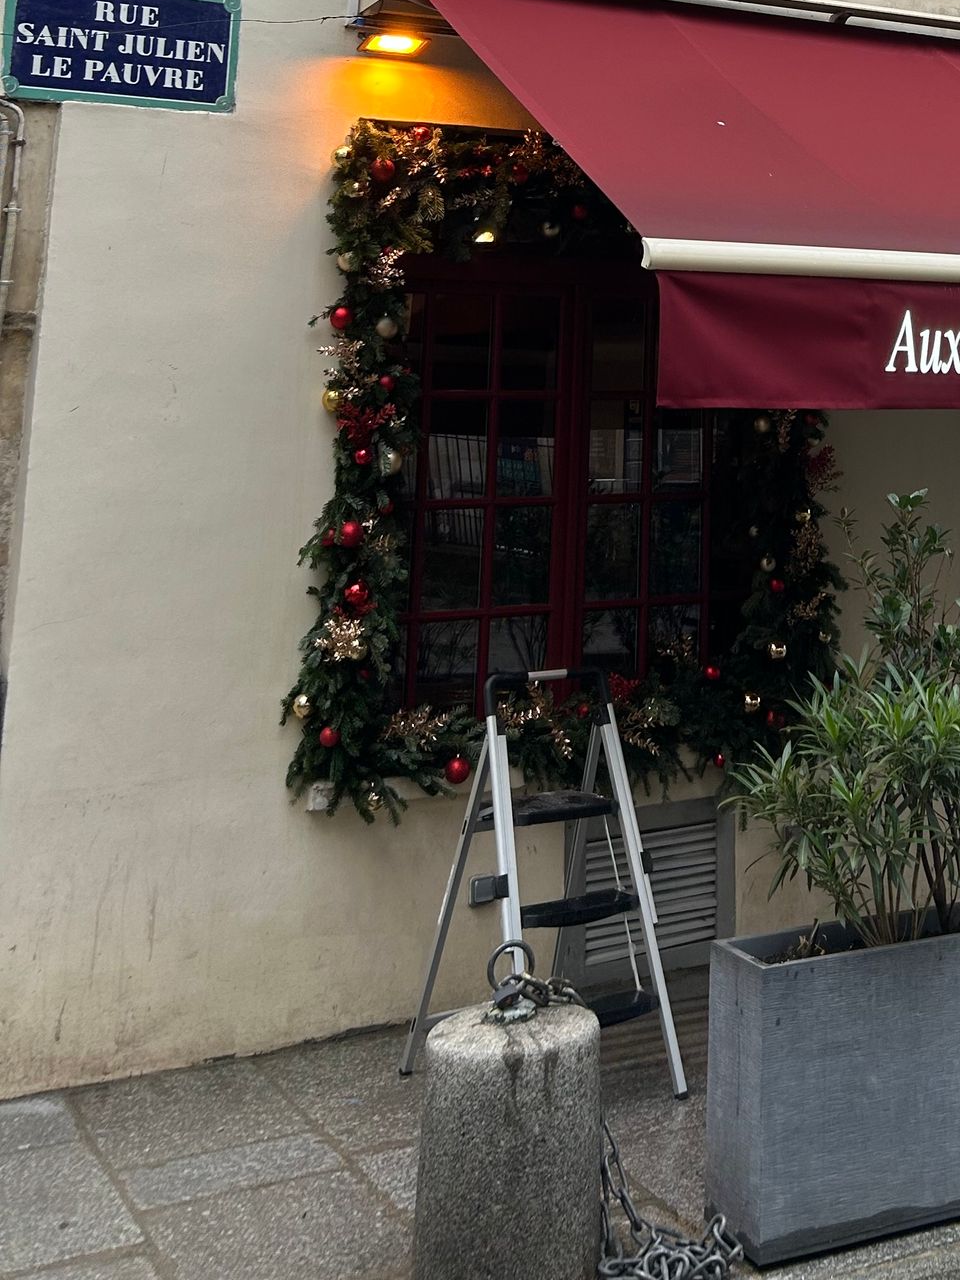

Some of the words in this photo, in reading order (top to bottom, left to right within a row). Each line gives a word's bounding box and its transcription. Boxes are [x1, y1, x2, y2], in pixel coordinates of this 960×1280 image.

[95, 0, 159, 28] RUE
[16, 22, 109, 52] SAINT
[118, 33, 226, 64] JULIEN
[31, 54, 72, 79] LE
[83, 59, 204, 91] PAUVRE
